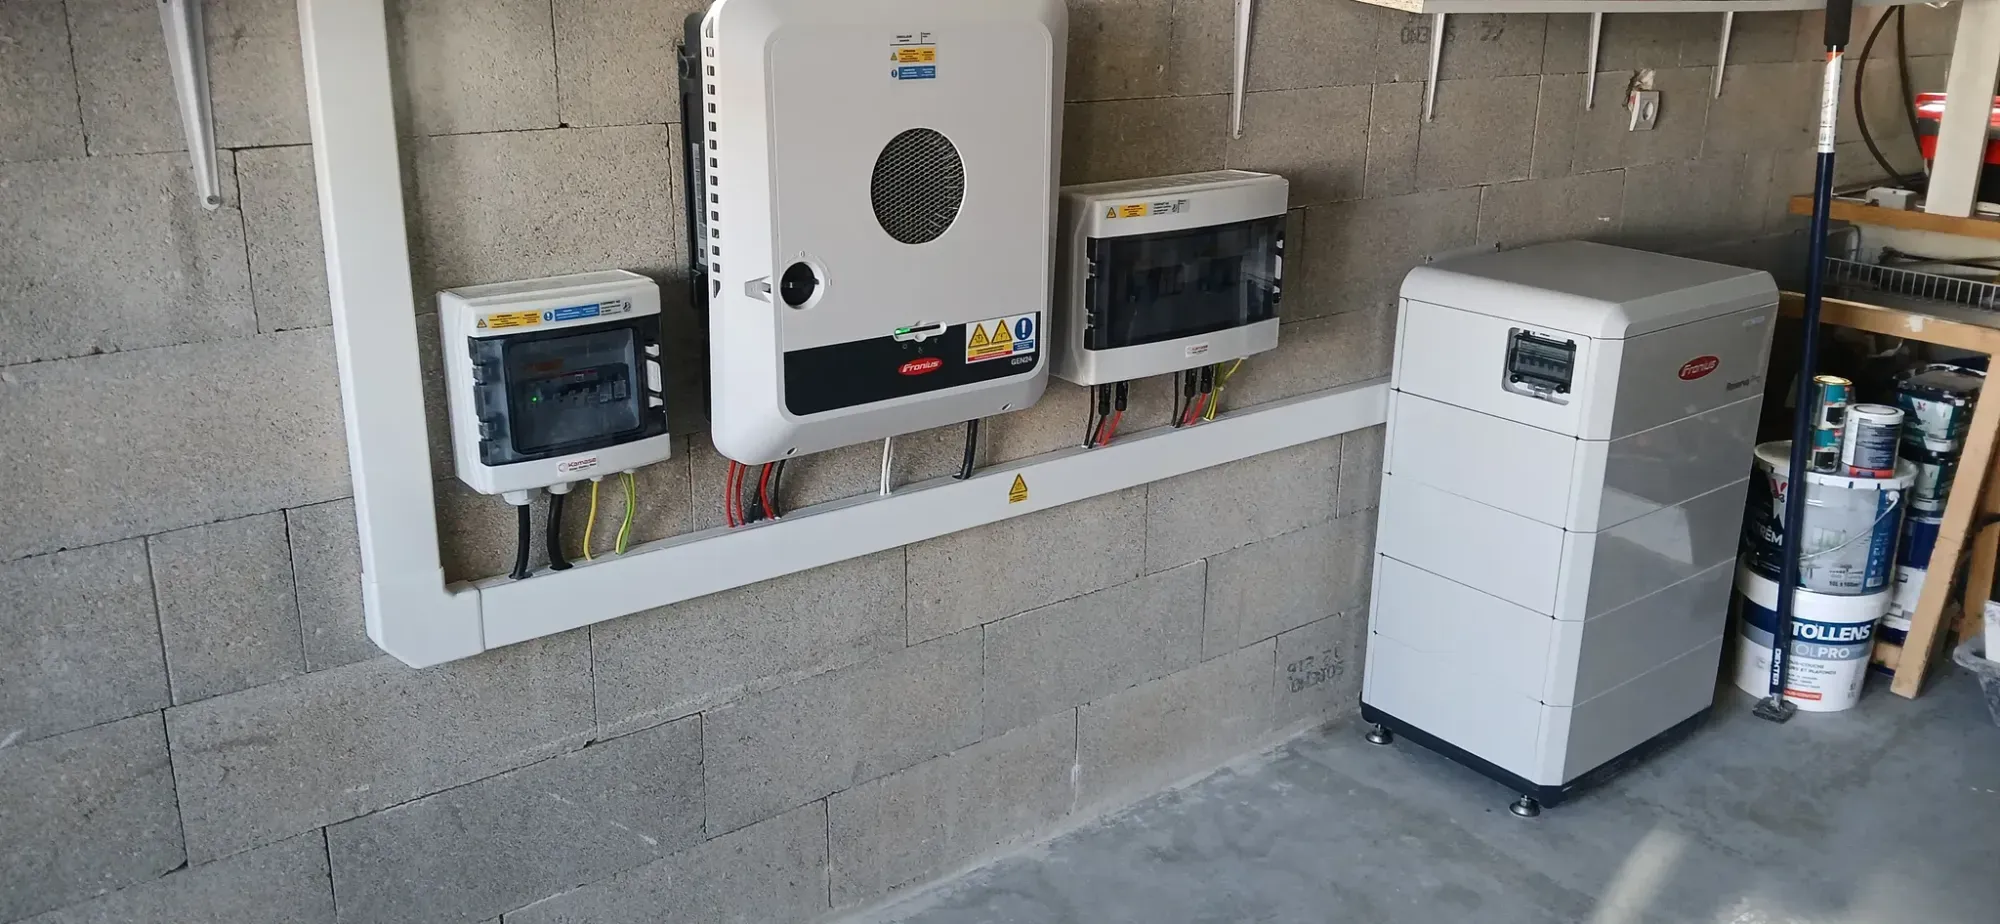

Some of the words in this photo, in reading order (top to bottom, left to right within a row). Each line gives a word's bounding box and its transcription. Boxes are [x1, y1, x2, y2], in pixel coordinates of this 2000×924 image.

[902, 359, 940, 373] Fronius
[1011, 355, 1033, 366] GEN24
[1681, 360, 1717, 377] Fronius
[1792, 621, 1871, 641] TOLLENS
[1795, 643, 1850, 659] OLPRO
[1772, 648, 1782, 686] DEXTER
